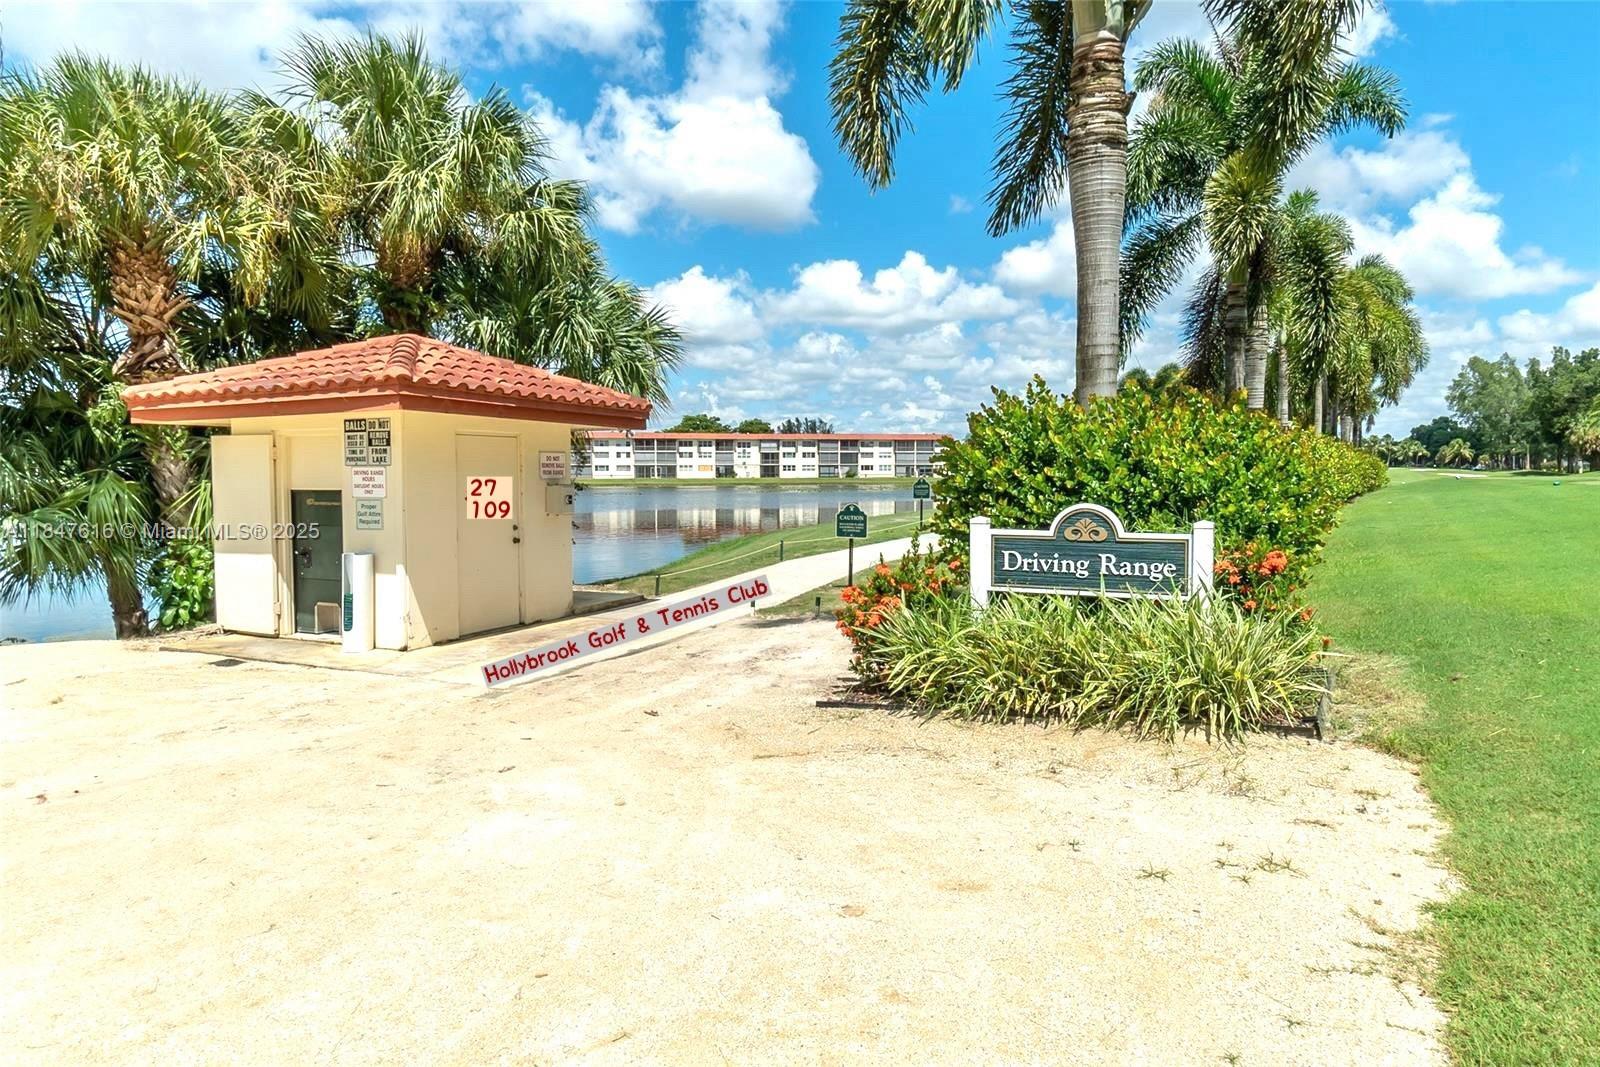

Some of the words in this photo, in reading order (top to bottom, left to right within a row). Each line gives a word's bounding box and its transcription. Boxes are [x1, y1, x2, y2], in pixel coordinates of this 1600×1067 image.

[345, 420, 366, 431] BALLS
[368, 420, 376, 430] DO
[378, 420, 389, 430] NOT
[1001, 550, 1090, 578] Driving
[1098, 553, 1177, 582] Range
